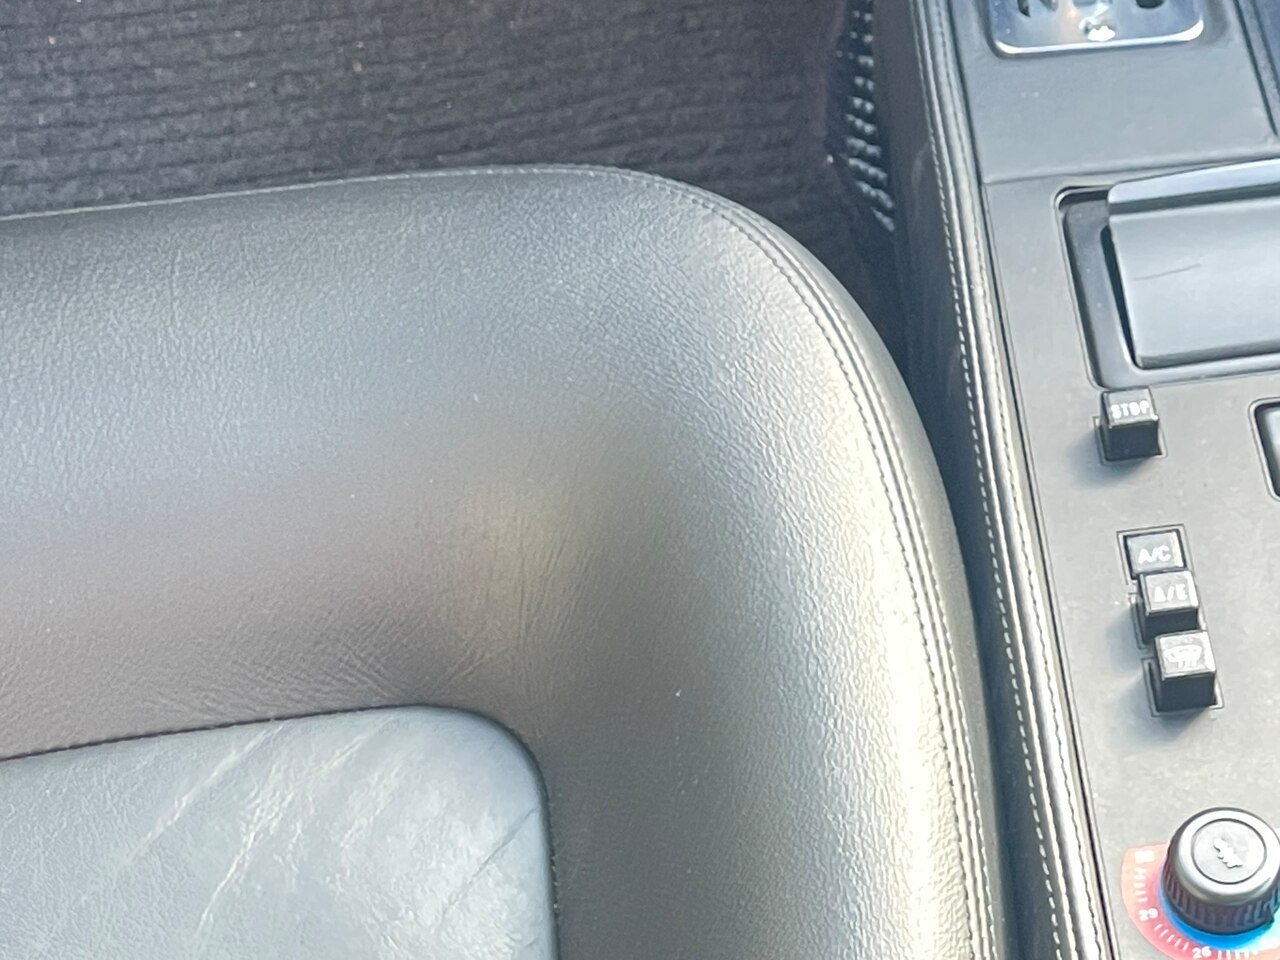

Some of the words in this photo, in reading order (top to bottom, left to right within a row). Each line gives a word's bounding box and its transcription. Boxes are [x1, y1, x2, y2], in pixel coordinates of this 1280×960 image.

[1110, 399, 1150, 419] STOP
[1138, 544, 1171, 564] A/C
[1192, 946, 1212, 959] 26
